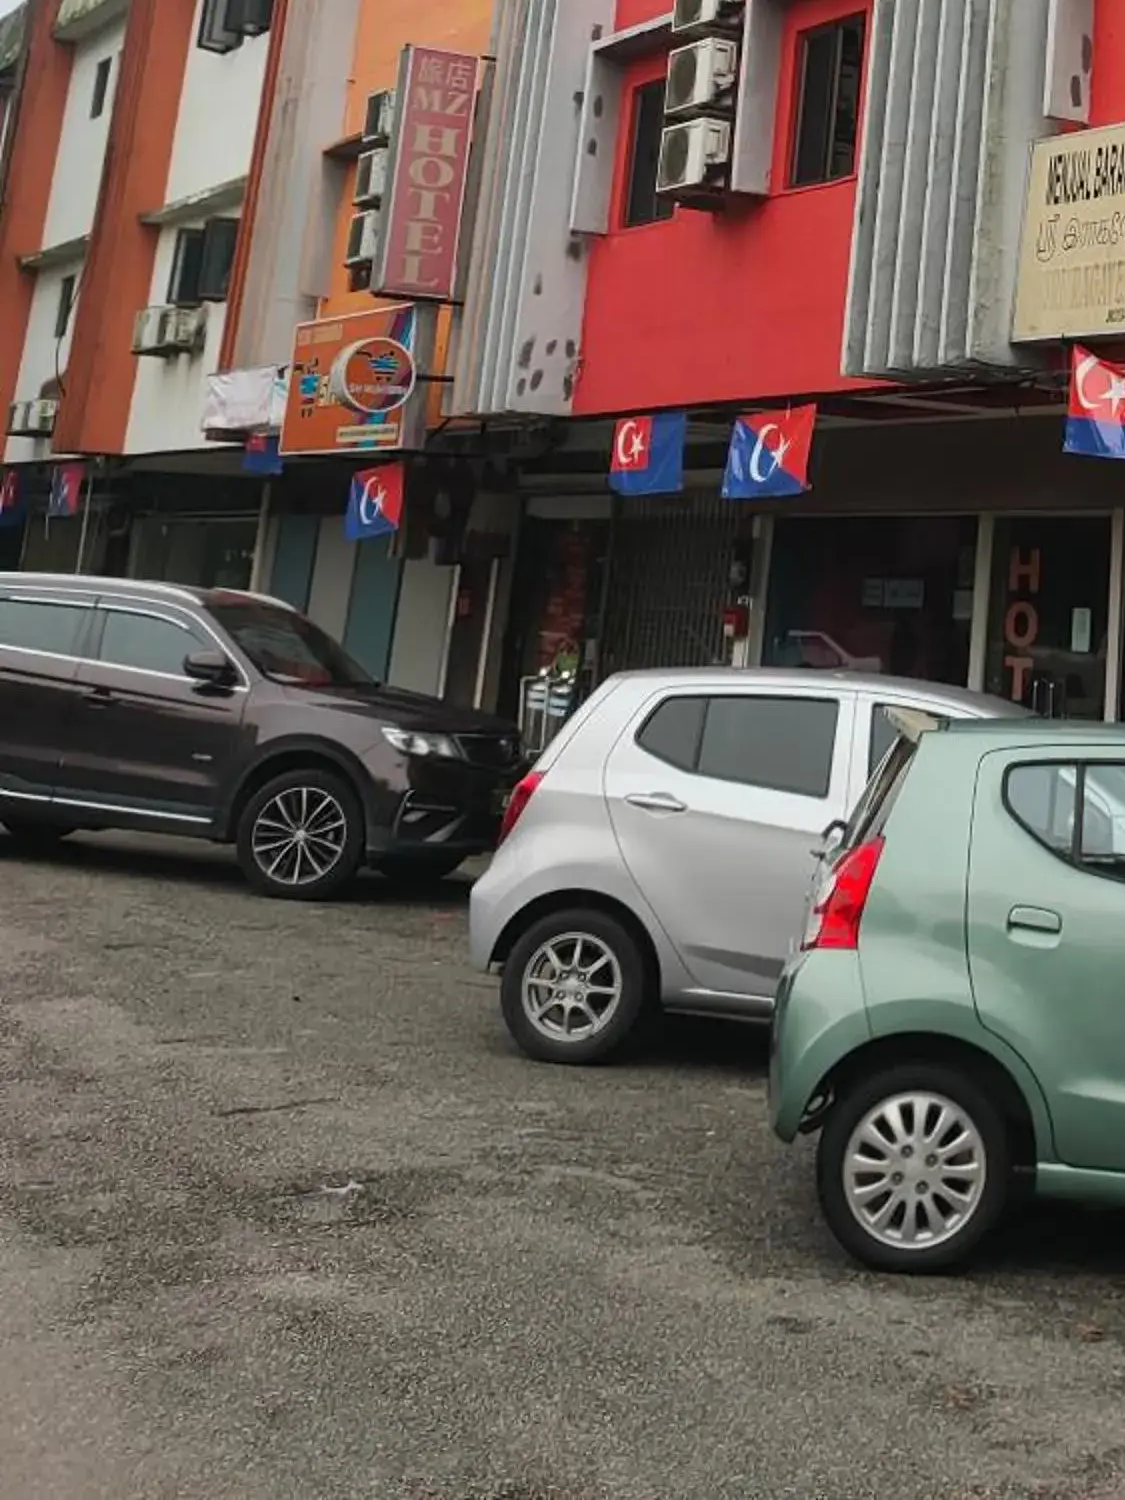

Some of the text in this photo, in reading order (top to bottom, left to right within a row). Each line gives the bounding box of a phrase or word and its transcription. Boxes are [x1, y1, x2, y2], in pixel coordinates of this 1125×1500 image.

[418, 56, 473, 92] 旅店
[412, 86, 470, 117] MZ
[396, 122, 463, 288] HOTEL
